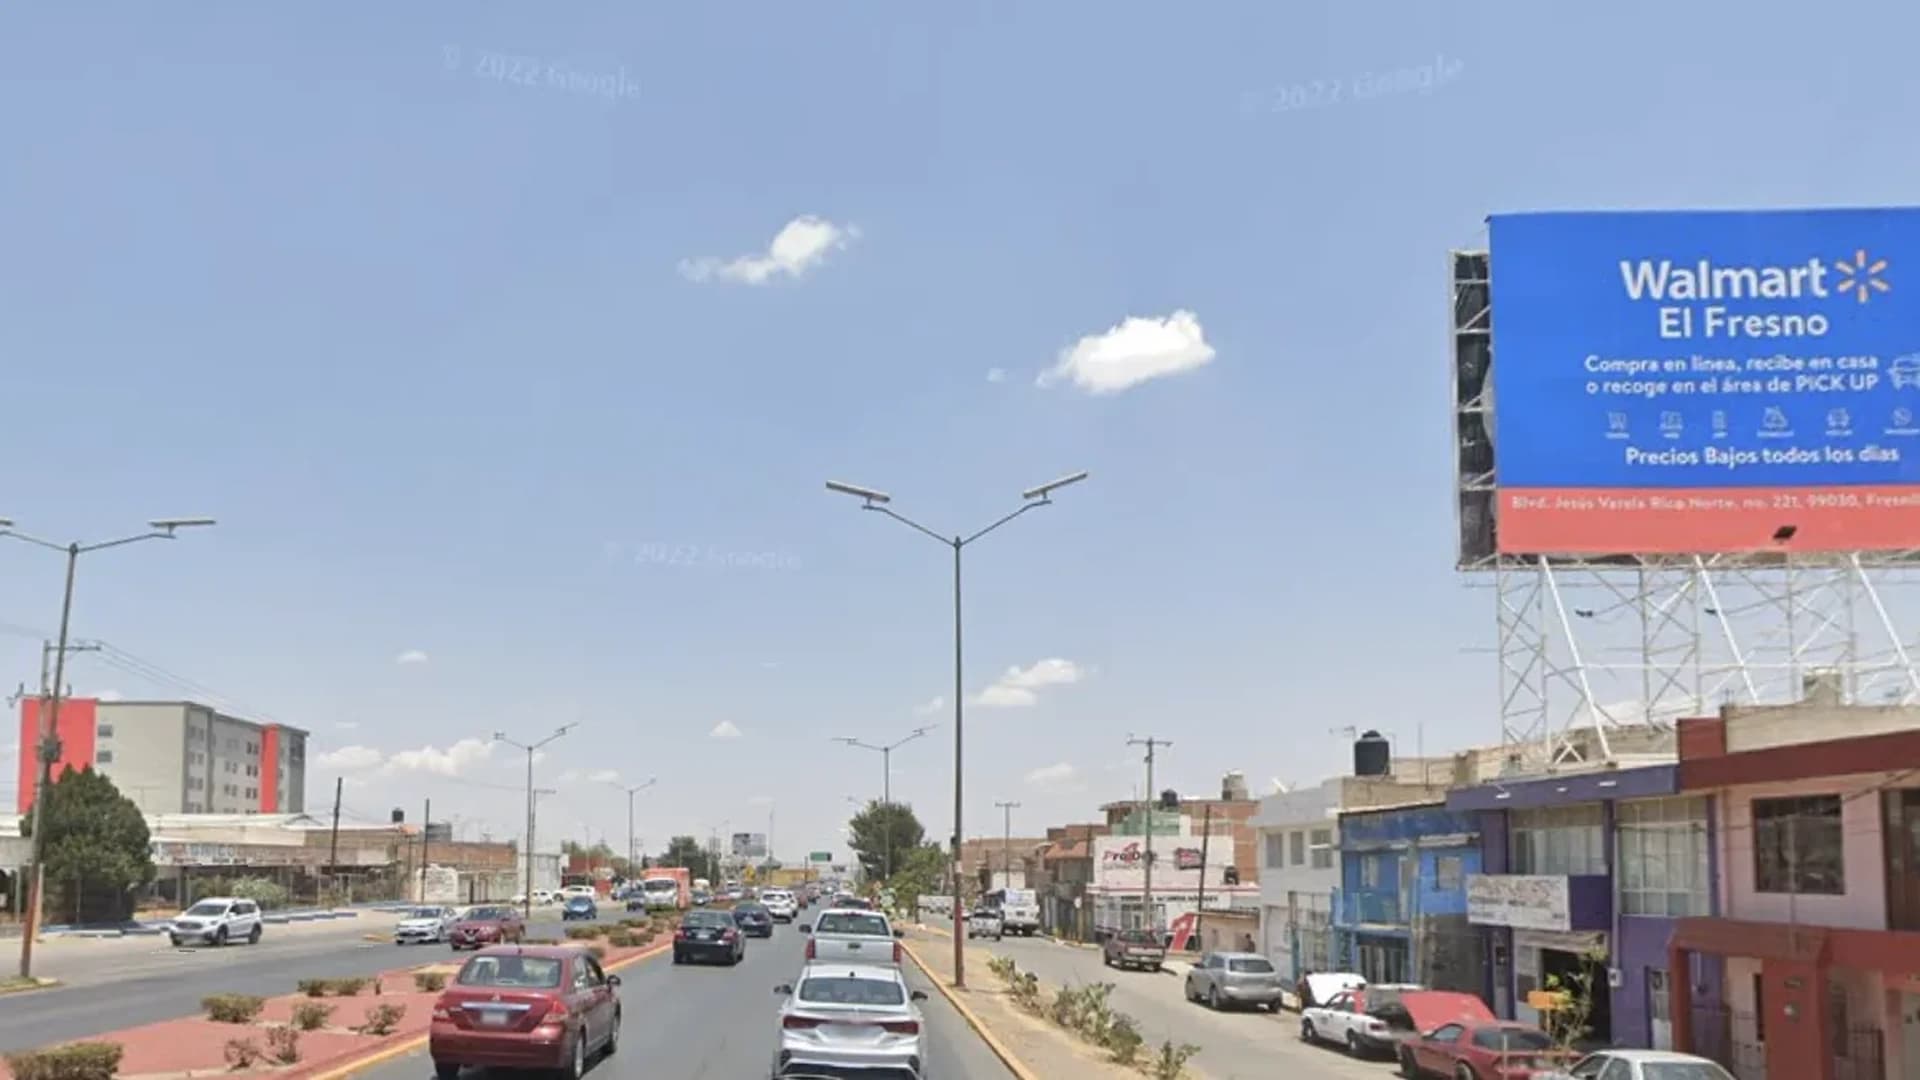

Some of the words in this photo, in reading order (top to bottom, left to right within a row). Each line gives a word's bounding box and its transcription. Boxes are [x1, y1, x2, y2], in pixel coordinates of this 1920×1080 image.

[1619, 257, 1828, 300] Walmart
[1660, 307, 1692, 338] El
[1704, 306, 1829, 337] Fresno
[1585, 355, 1659, 375] Compra
[1664, 359, 1687, 372] en
[1746, 354, 1804, 370] recibe
[1808, 357, 1832, 370] en
[1836, 356, 1878, 370] casa
[1586, 381, 1599, 394] o
[1603, 380, 1668, 398] recoge
[1672, 381, 1696, 393] en
[1700, 377, 1717, 393] el
[1722, 376, 1761, 393] área
[1767, 376, 1791, 392] de
[1796, 373, 1846, 392] PICK
[1849, 373, 1879, 390] UP
[1625, 447, 1699, 466] Precios
[1705, 446, 1758, 469] Bajos
[1762, 446, 1820, 464] todos
[1825, 445, 1853, 463] los
